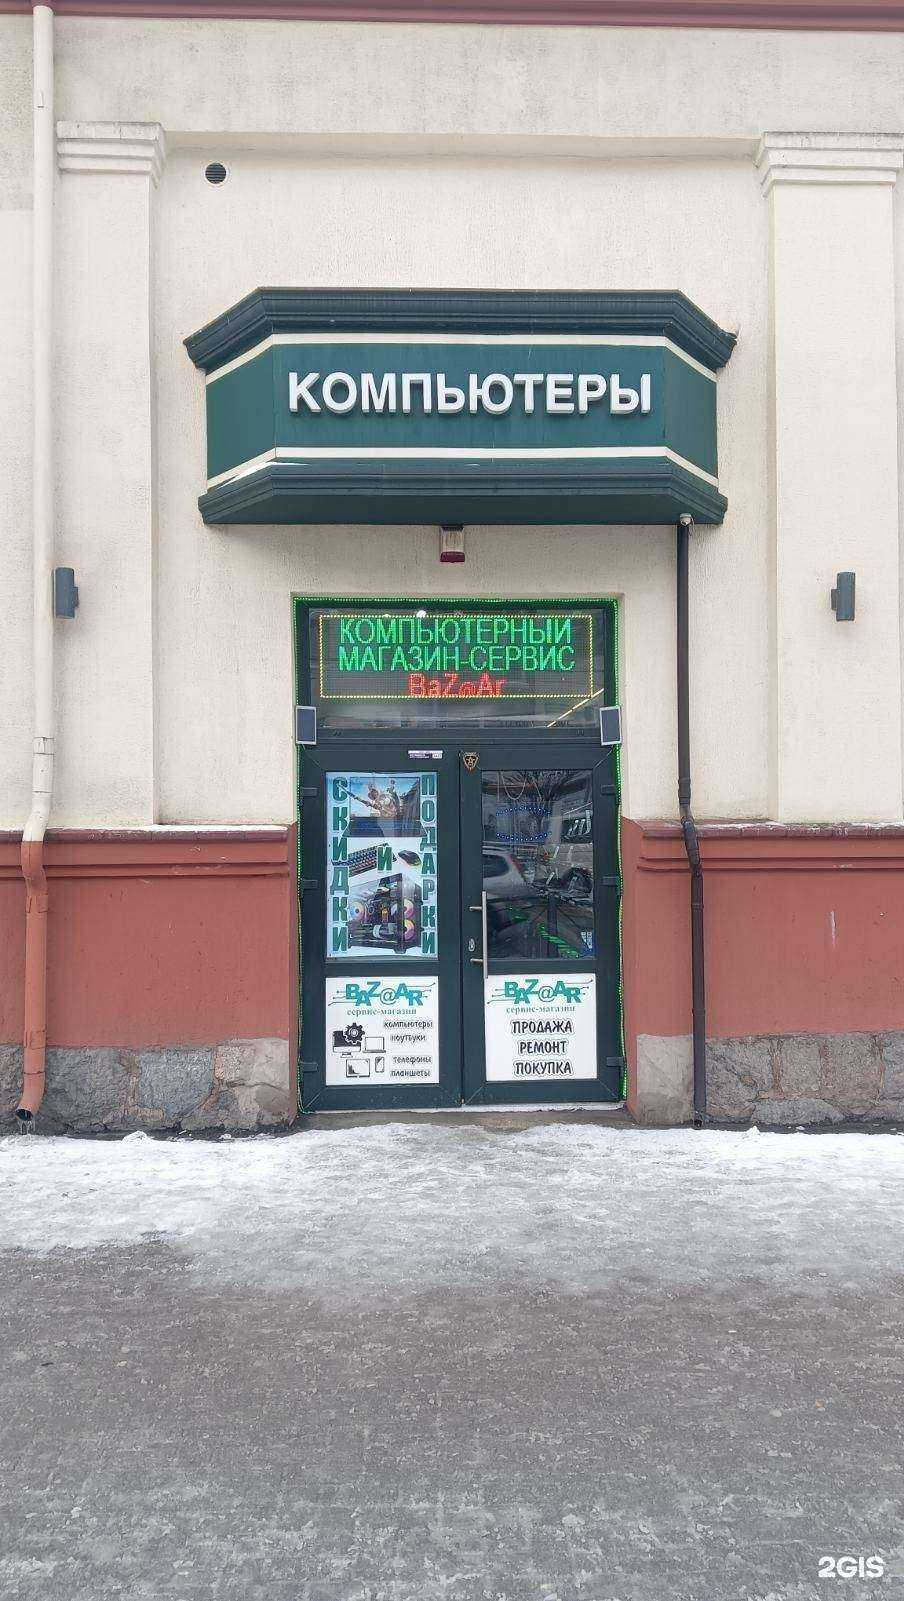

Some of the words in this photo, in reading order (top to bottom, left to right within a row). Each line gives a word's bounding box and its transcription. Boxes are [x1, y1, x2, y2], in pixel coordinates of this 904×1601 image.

[287, 370, 652, 414] КОМПЬЮТЕРЫ
[338, 645, 576, 671] МАГАЗИН-СЕРВИС
[420, 774, 436, 954] ПОДАРКИ
[345, 981, 424, 1006] BAZ@AR
[504, 979, 582, 1004] BAZ@AR
[511, 1020, 575, 1034] ПРОДАЖА
[518, 1040, 568, 1054] РЕМОНТ
[514, 1060, 574, 1075] ПОКУПКА
